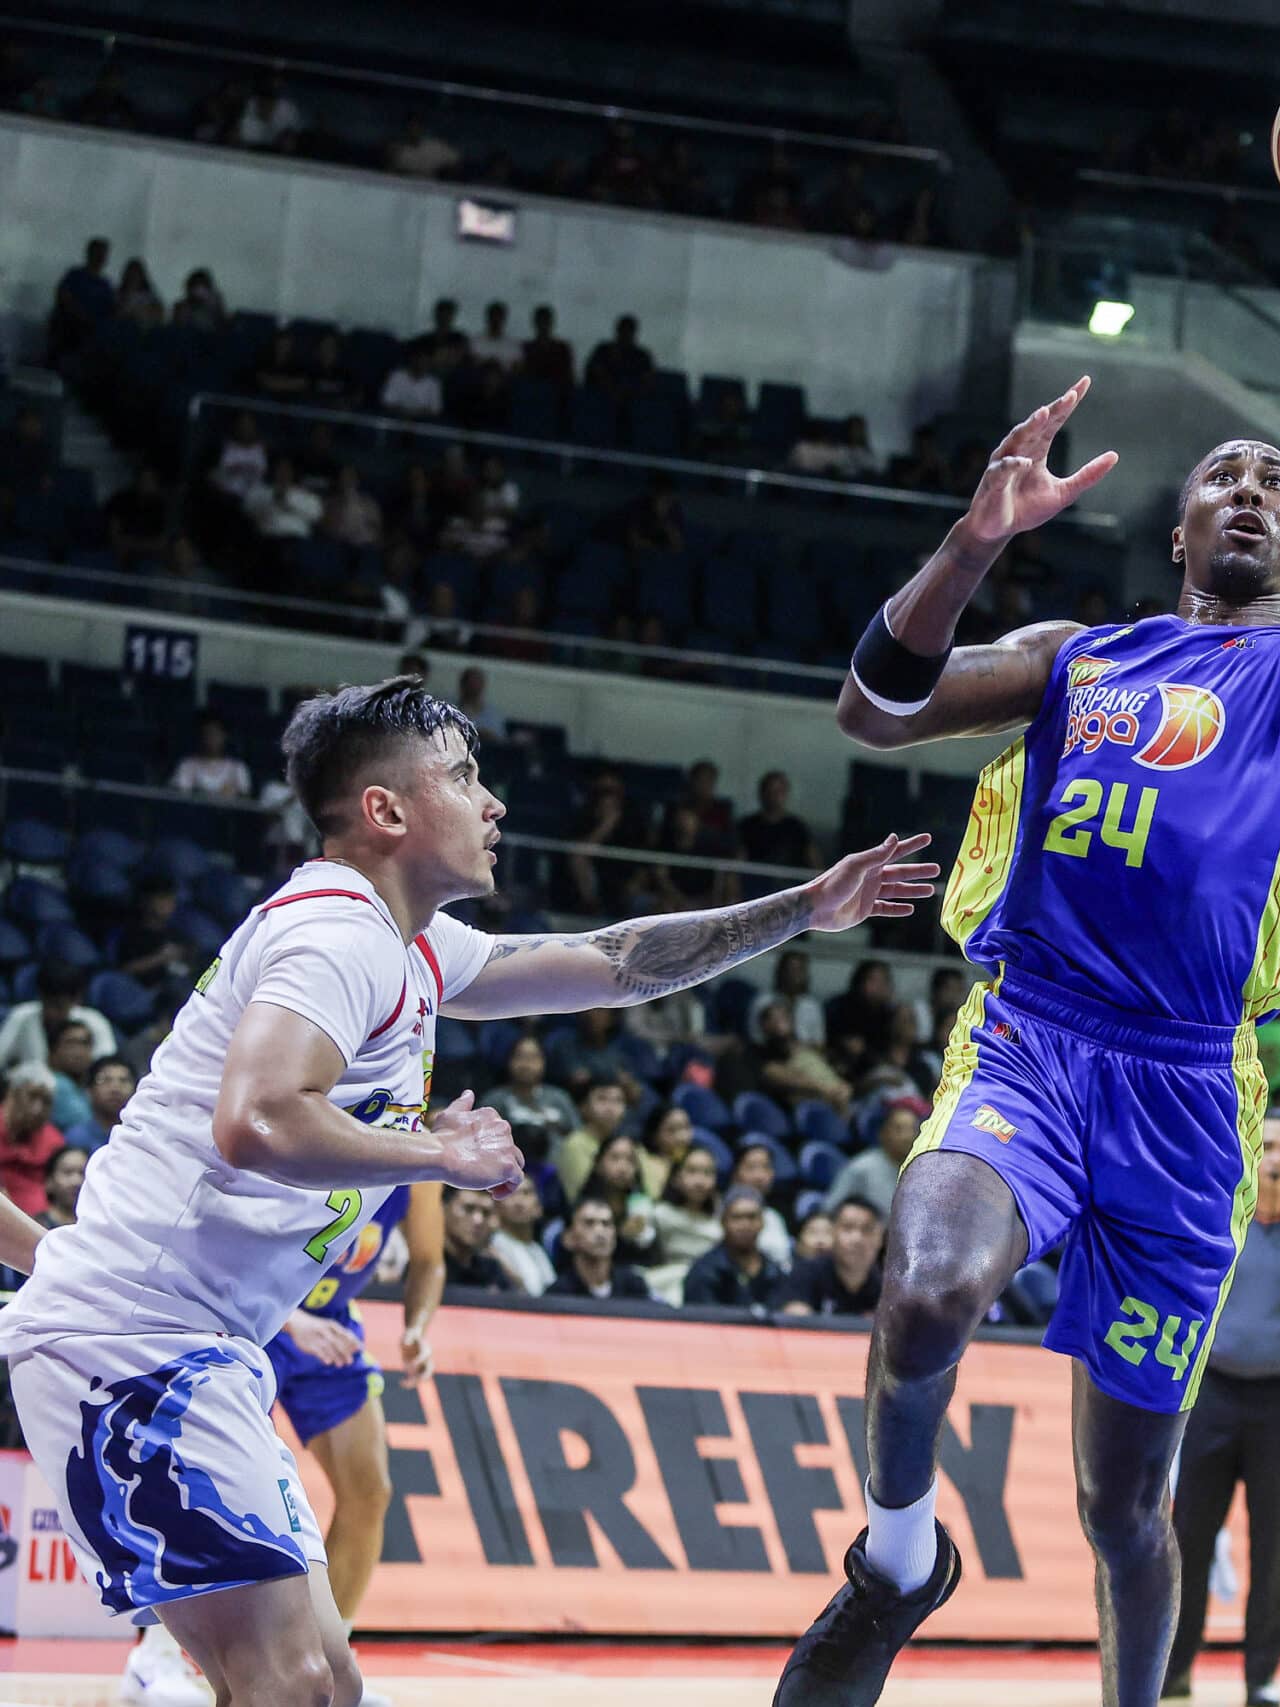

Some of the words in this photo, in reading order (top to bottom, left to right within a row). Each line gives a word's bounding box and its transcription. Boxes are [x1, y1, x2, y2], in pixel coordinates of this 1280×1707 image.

[132, 634, 193, 678] 115
[1042, 778, 1160, 868] 24
[1104, 1296, 1203, 1380] 24
[379, 1370, 1024, 1580] FIREFY
